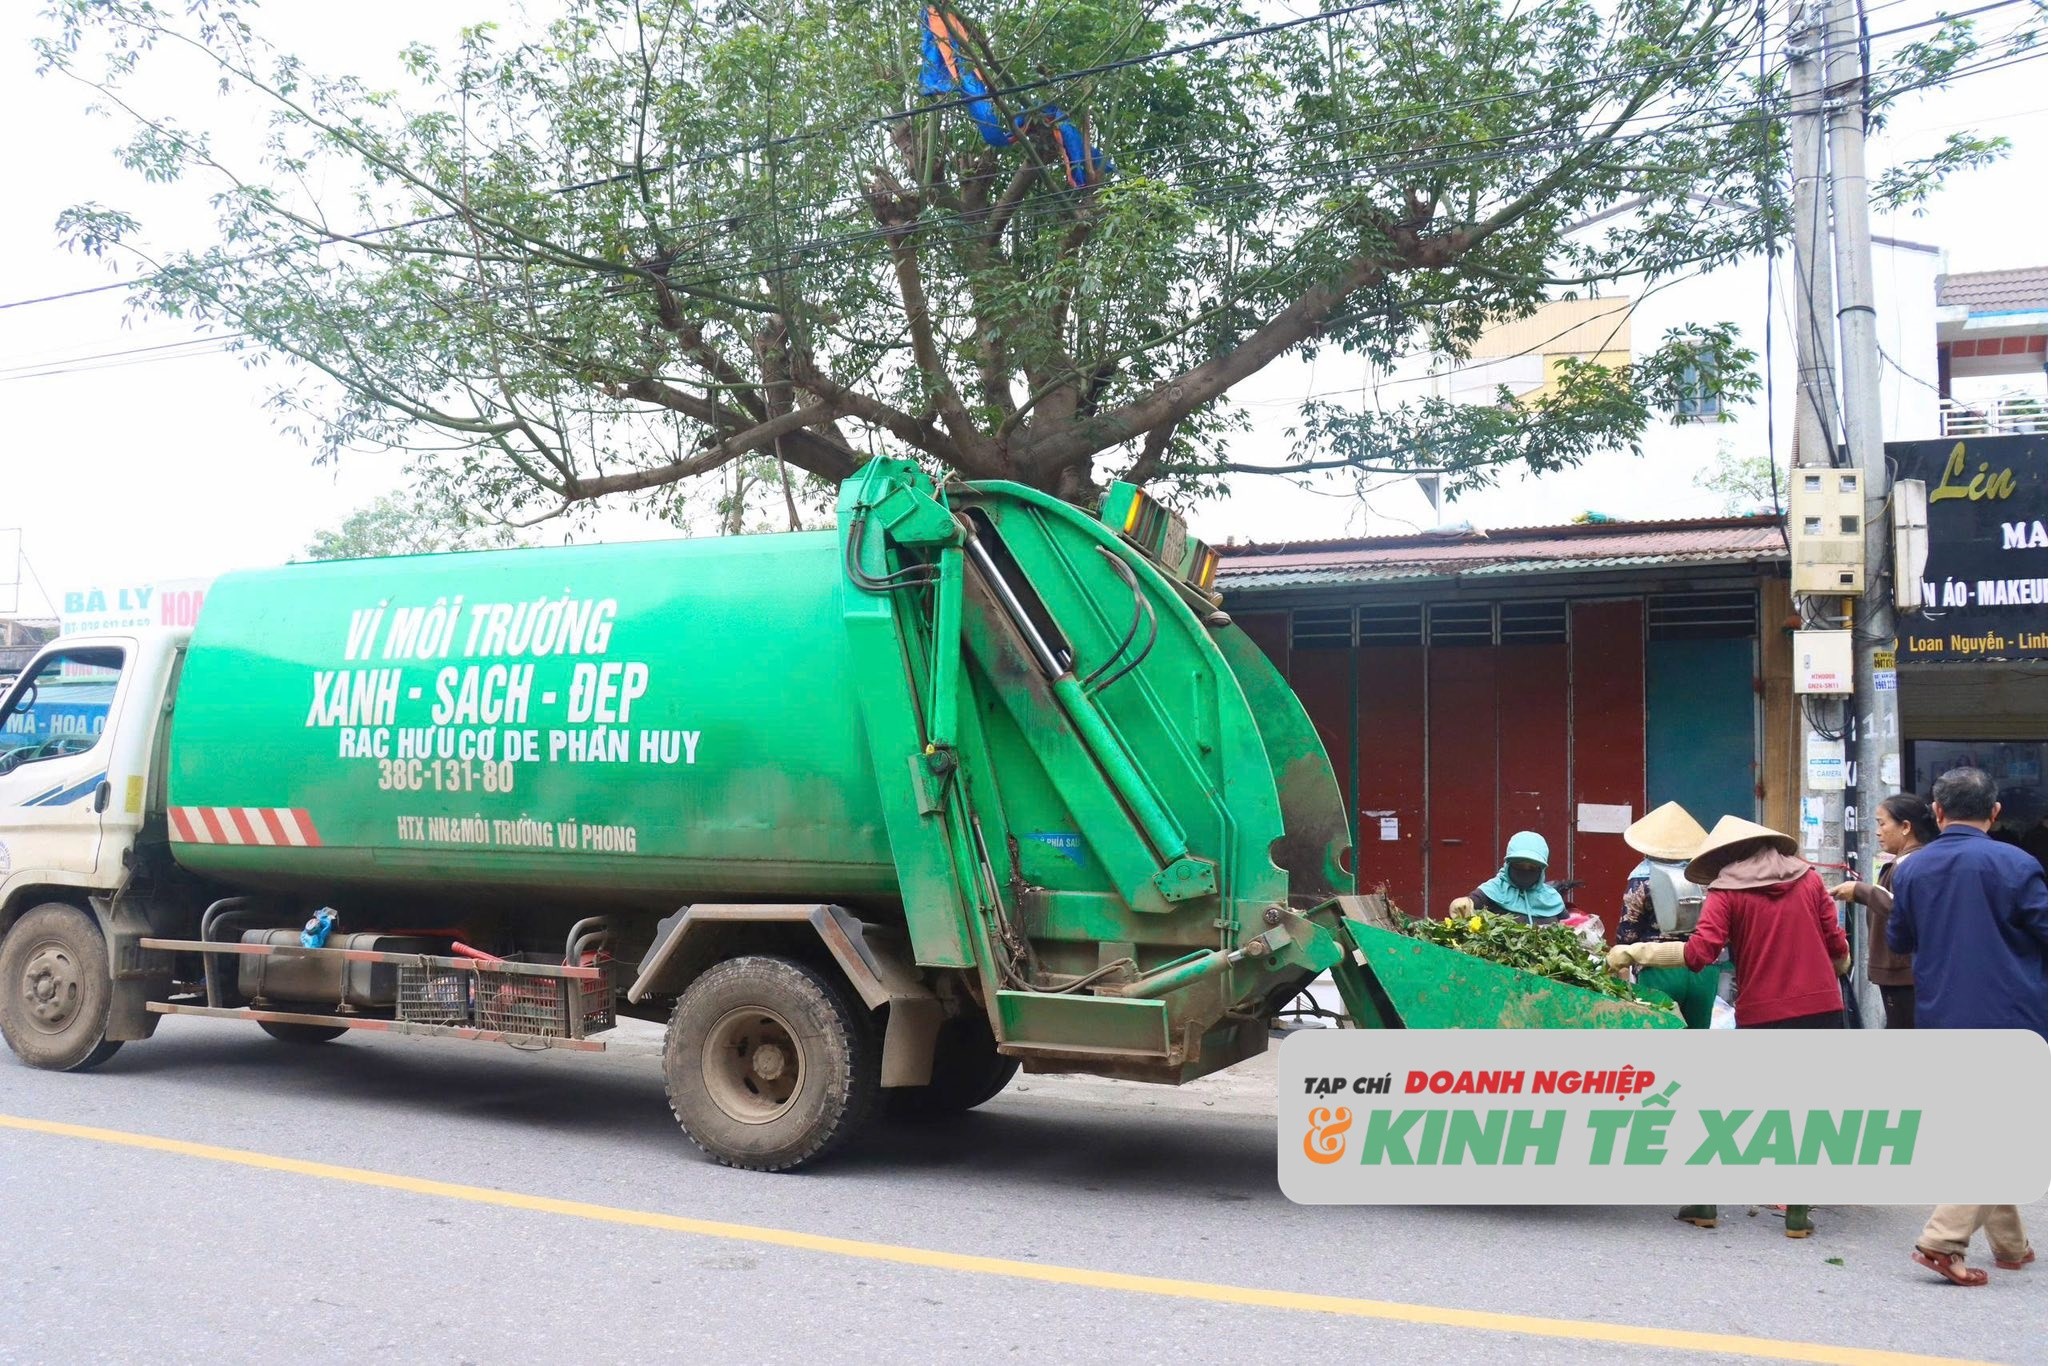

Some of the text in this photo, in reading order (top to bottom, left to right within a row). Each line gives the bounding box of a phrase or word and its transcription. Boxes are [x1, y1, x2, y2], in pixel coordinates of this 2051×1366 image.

[1929, 441, 2017, 504] Lin
[64, 586, 108, 613] BÀ
[119, 584, 154, 611] LÝ
[1909, 635, 1943, 652] Loan
[1951, 630, 2004, 654] Nguyễn
[2018, 633, 2048, 650] Linh
[305, 668, 402, 727] XANH
[50, 714, 87, 735] HOA
[339, 727, 390, 758] RAC
[503, 729, 541, 762] DE
[639, 730, 700, 764] HUY
[378, 759, 514, 792] 38C-131-80
[397, 813, 636, 852] HTX NN&MÔI TRƯỜNG VŨ PHONG
